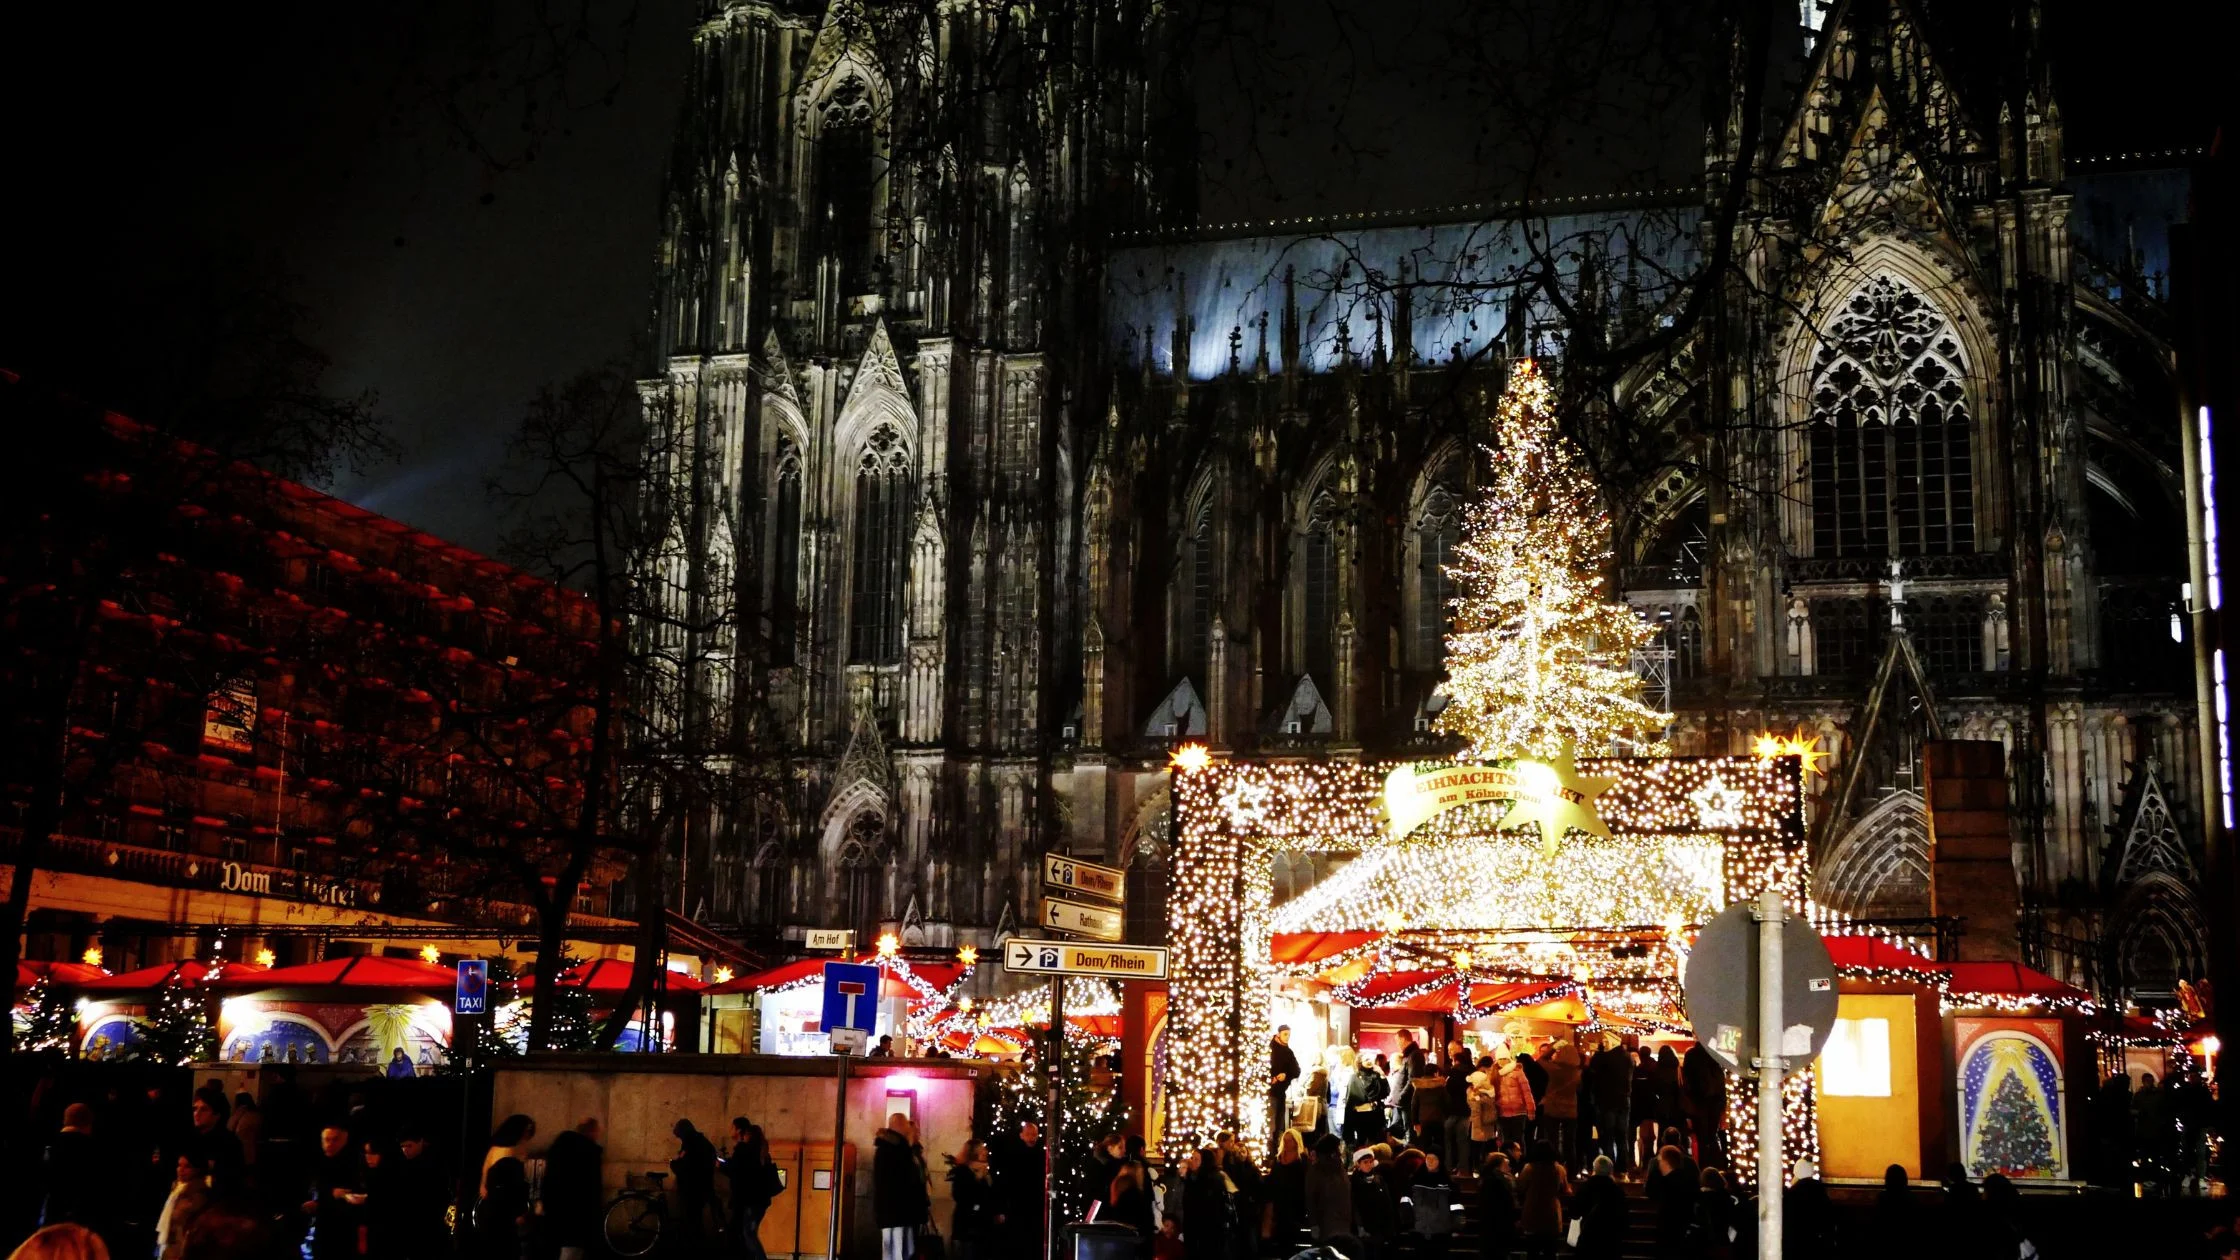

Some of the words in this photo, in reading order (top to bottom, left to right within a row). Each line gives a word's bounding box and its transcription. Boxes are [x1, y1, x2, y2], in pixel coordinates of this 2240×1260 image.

[1415, 772, 1585, 806] EIHNACHTSKT
[1438, 794, 1458, 804] am
[1465, 788, 1509, 800] Kölner
[1513, 790, 1541, 805] Dom
[220, 860, 270, 895] Dom
[1080, 871, 1115, 891] Dom/Rhein
[813, 934, 824, 944] Am
[826, 934, 839, 944] Hof
[1076, 952, 1145, 970] Dom/Rhein
[459, 997, 482, 1008] TAXI
